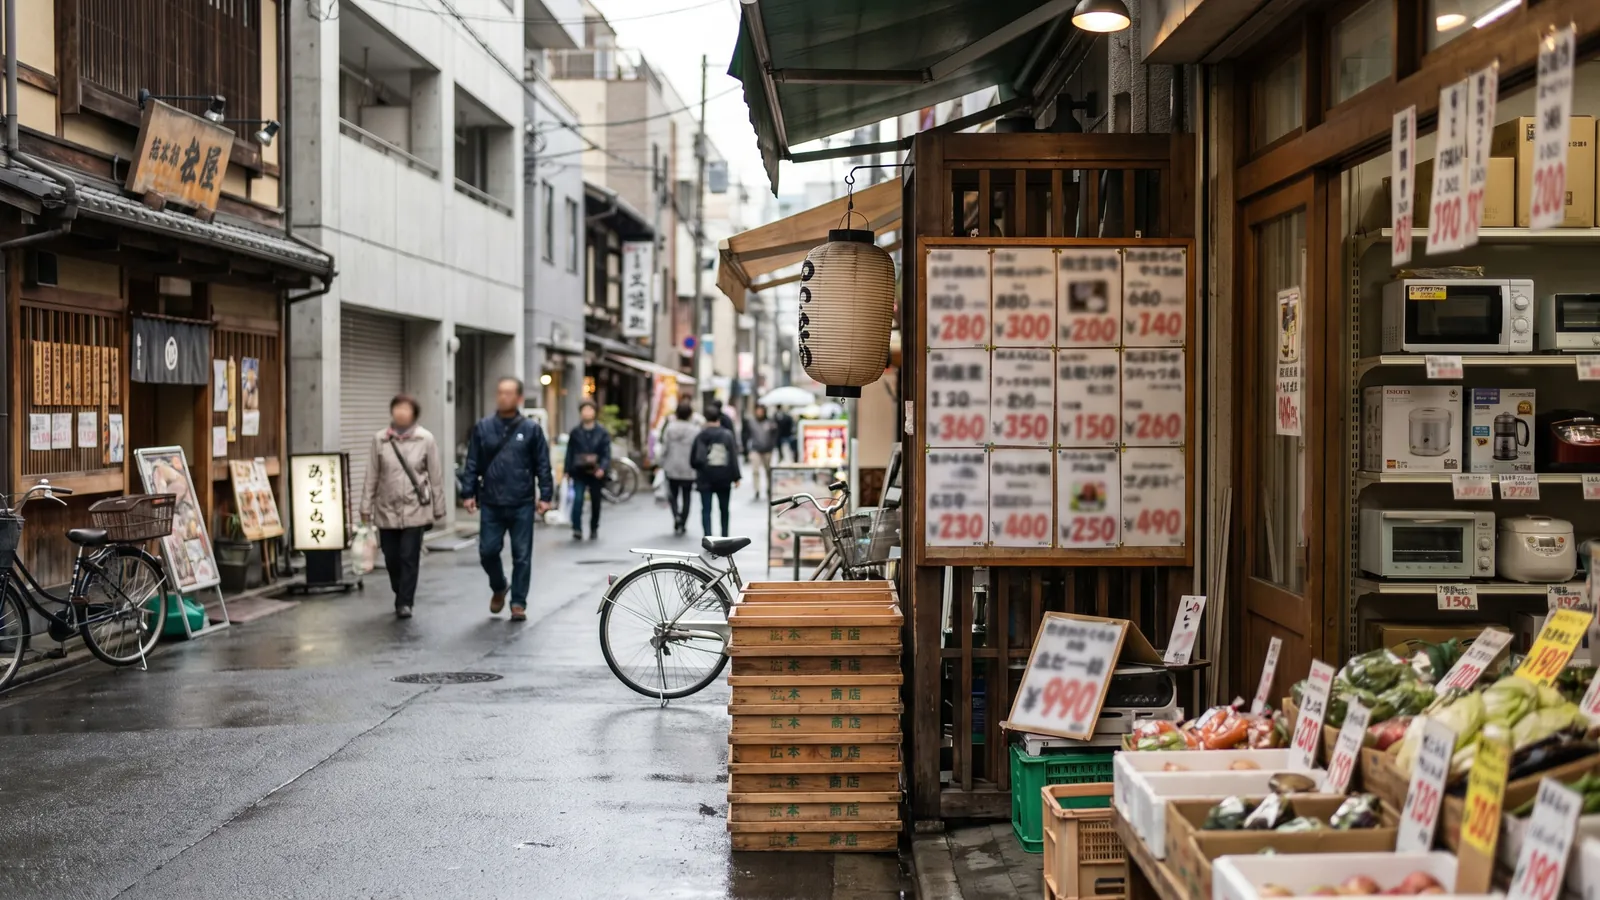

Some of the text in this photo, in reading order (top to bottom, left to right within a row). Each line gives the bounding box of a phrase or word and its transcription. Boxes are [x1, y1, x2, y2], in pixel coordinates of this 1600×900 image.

[930, 314, 985, 340] ¥280
[996, 314, 1051, 340] ¥300
[1061, 317, 1117, 341] ¥200
[930, 413, 985, 440] ¥360
[993, 413, 1048, 439] ¥350
[1060, 413, 1115, 439] ¥150
[1125, 413, 1181, 438] ¥260
[929, 513, 984, 540] ¥230
[992, 513, 1048, 539] ¥400
[1061, 516, 1116, 542] ¥250
[1125, 509, 1181, 535] ¥490
[1022, 676, 1098, 722] ¥990
